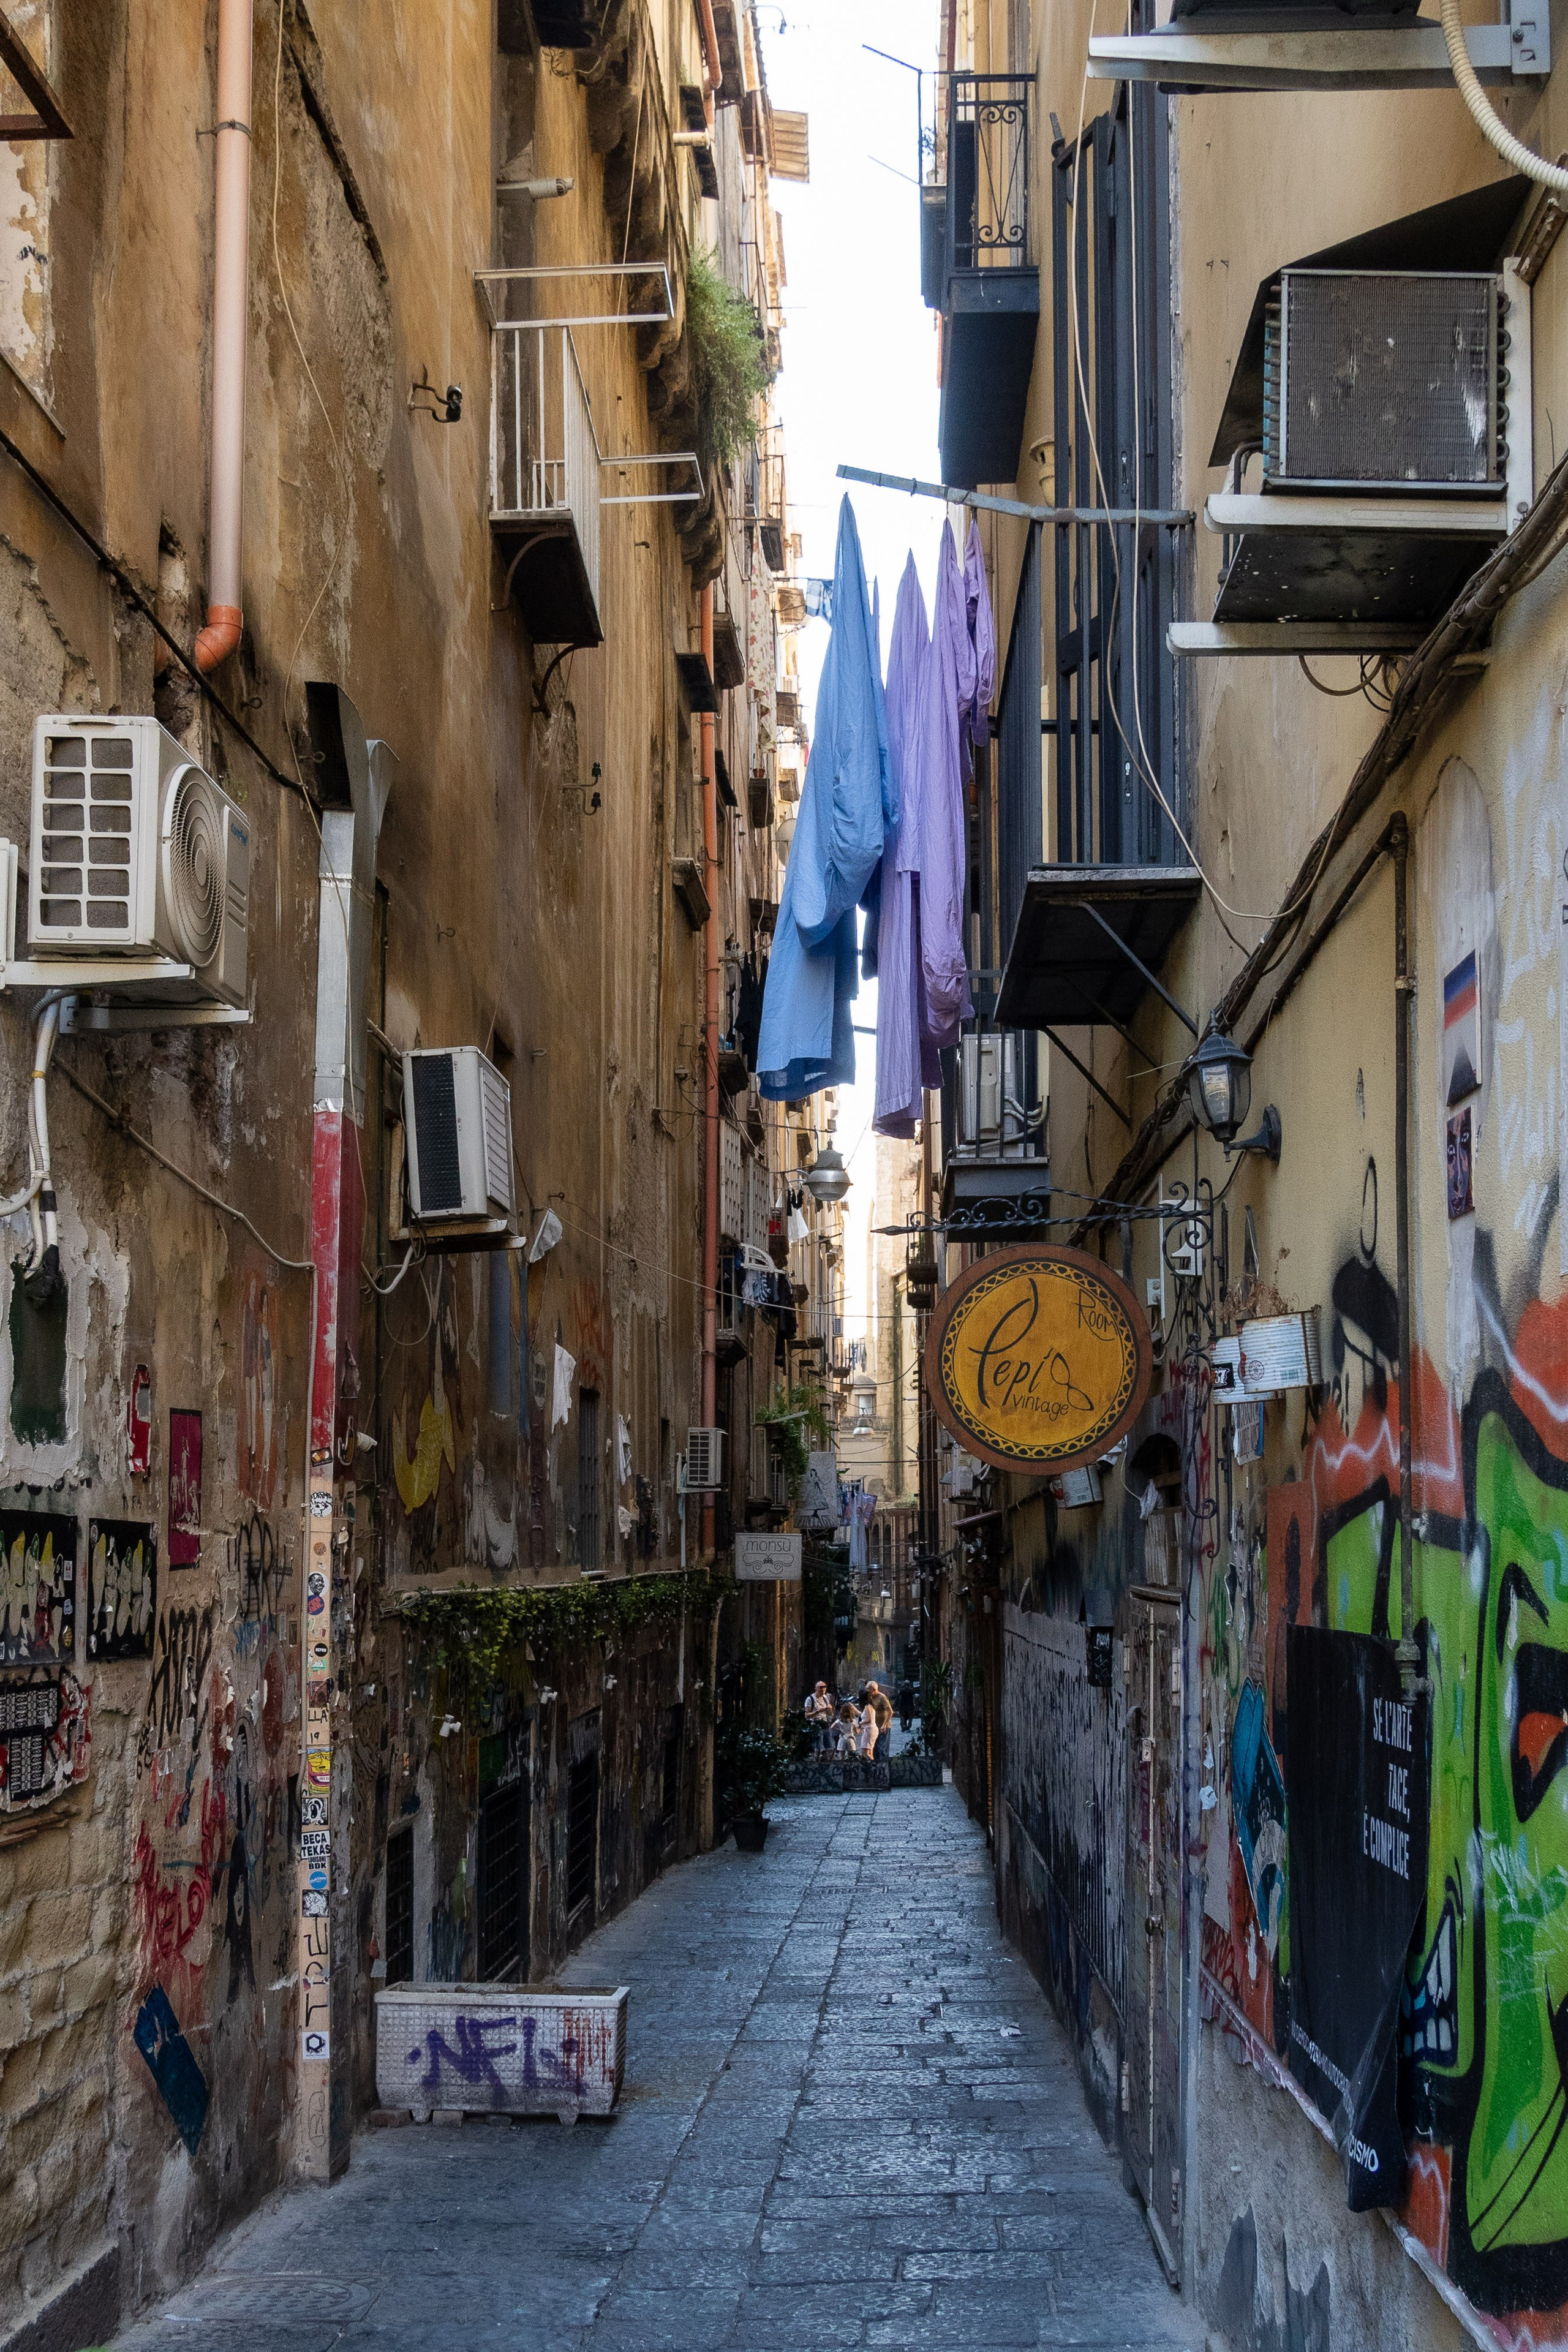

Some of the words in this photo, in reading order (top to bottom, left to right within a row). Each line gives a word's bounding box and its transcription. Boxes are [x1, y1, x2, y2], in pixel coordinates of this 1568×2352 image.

[1012, 1393, 1070, 1422] vintage
[1385, 1700, 1412, 1752] L'ARTE
[301, 1844, 331, 1858] TEKAS
[303, 1833, 328, 1845] BECA
[1370, 1816, 1409, 1880] COMPLICE
